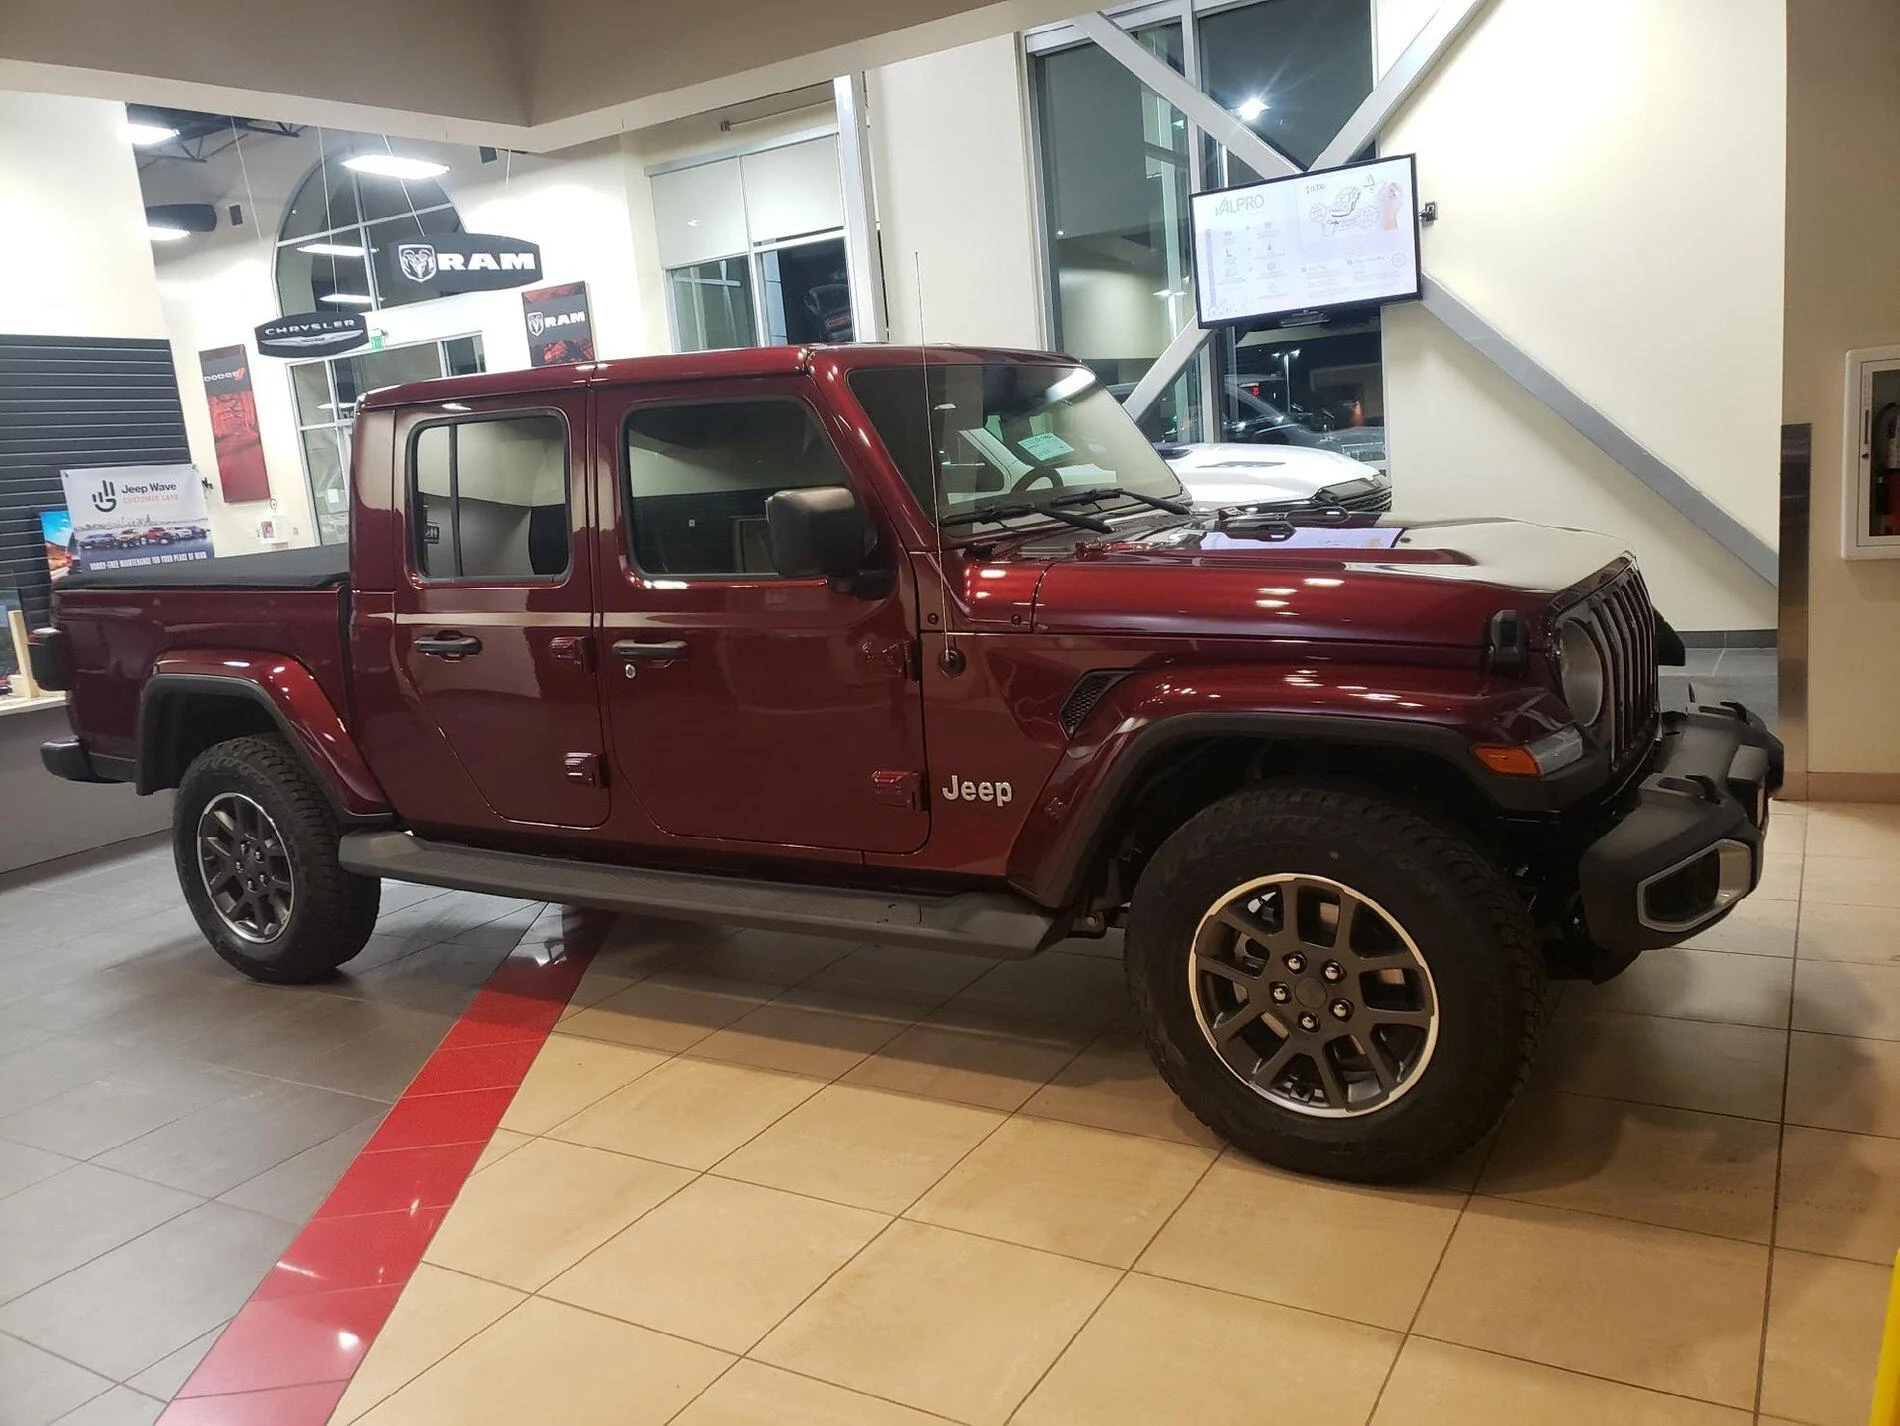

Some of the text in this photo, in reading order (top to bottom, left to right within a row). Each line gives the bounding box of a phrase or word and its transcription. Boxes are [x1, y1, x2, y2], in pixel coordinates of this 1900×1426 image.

[437, 253, 536, 270] RAM
[264, 319, 355, 336] CHRYSLER
[544, 310, 586, 328] RAM
[204, 370, 239, 382] DODGE
[121, 482, 177, 494] Jeep Wave
[943, 775, 1012, 807] Jeep
